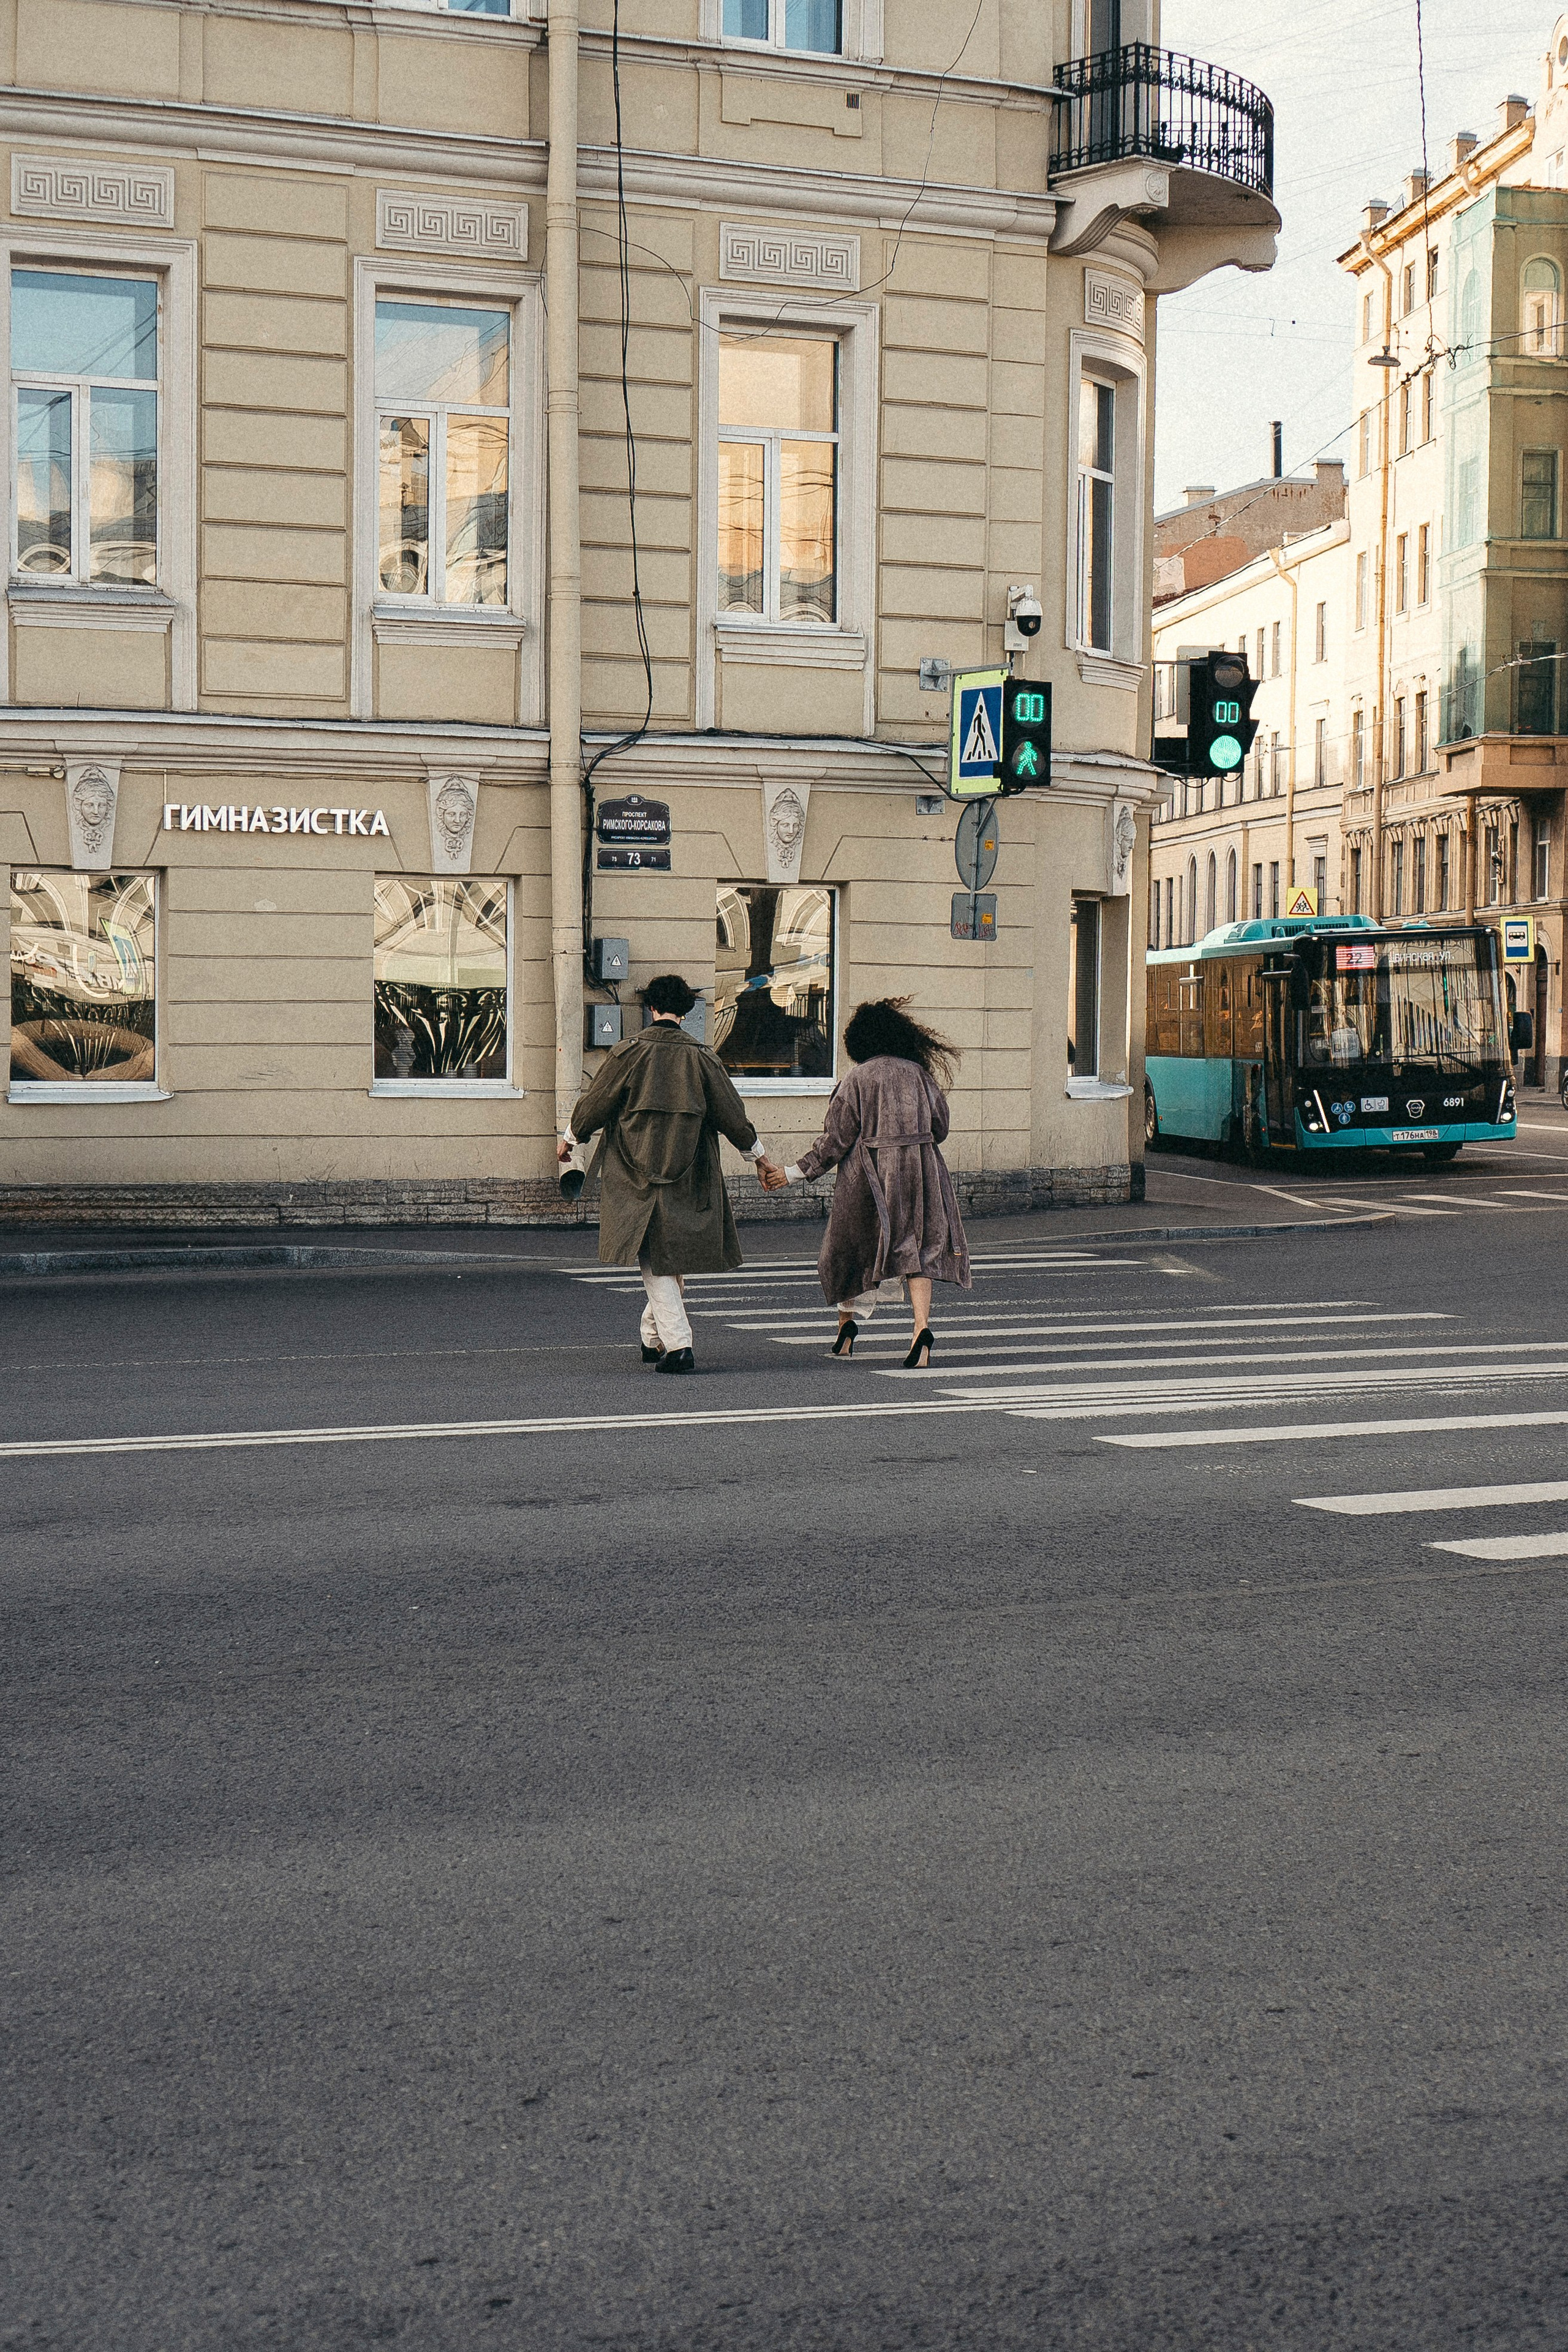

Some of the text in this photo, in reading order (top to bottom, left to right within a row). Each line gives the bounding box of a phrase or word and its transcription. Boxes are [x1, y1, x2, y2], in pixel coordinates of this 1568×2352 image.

[1016, 693, 1044, 722] 00
[1216, 701, 1239, 723] 00
[163, 804, 390, 836] ГИМНАЗИСТКА
[603, 819, 666, 831] РИМСКОГО-КОРСАКОВА
[627, 852, 641, 865] 73
[1346, 952, 1363, 964] 22
[1443, 1097, 1464, 1107] 6891
